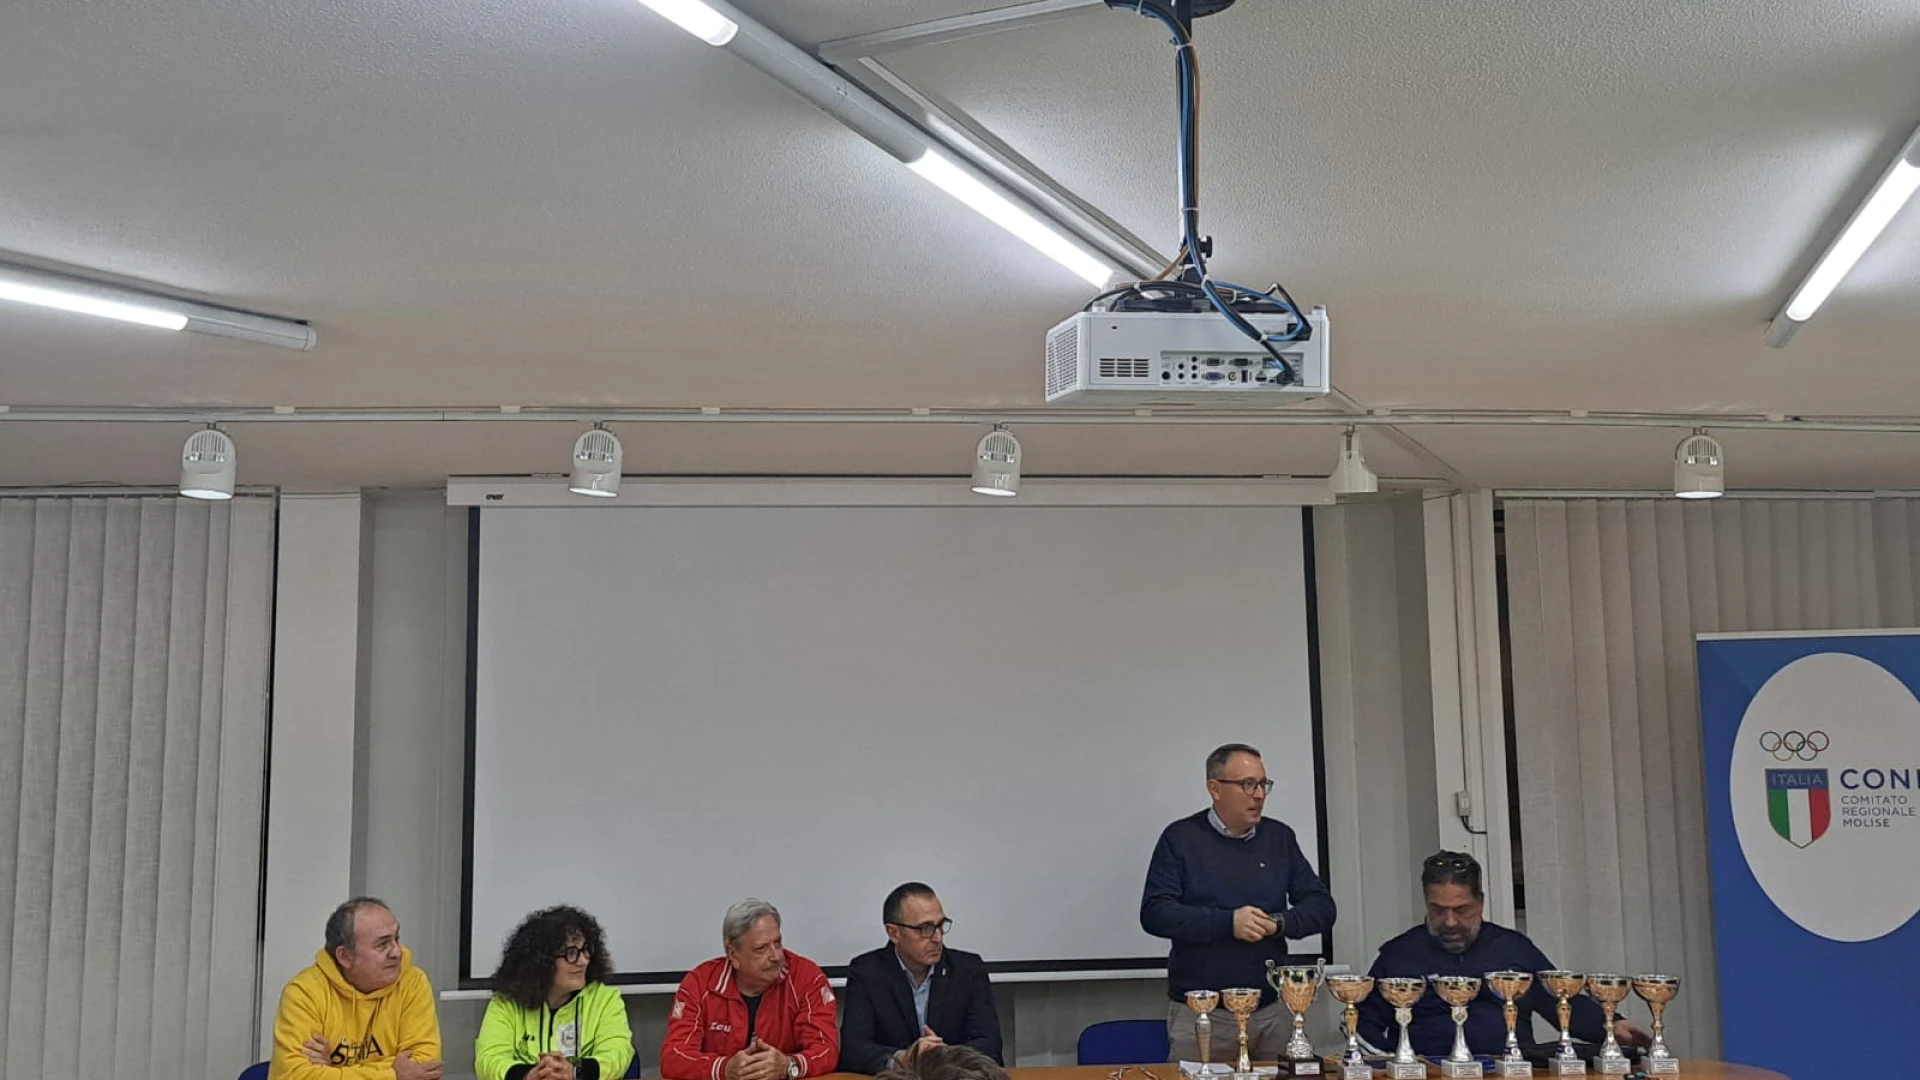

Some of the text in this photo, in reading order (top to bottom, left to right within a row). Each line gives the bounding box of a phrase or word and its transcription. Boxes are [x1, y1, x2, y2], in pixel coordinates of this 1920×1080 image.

[1772, 773, 1823, 786] ITALIA
[1841, 795, 1908, 805] COMITATO
[1842, 807, 1917, 817] REGIONALE
[1843, 818, 1891, 828] MOLISE
